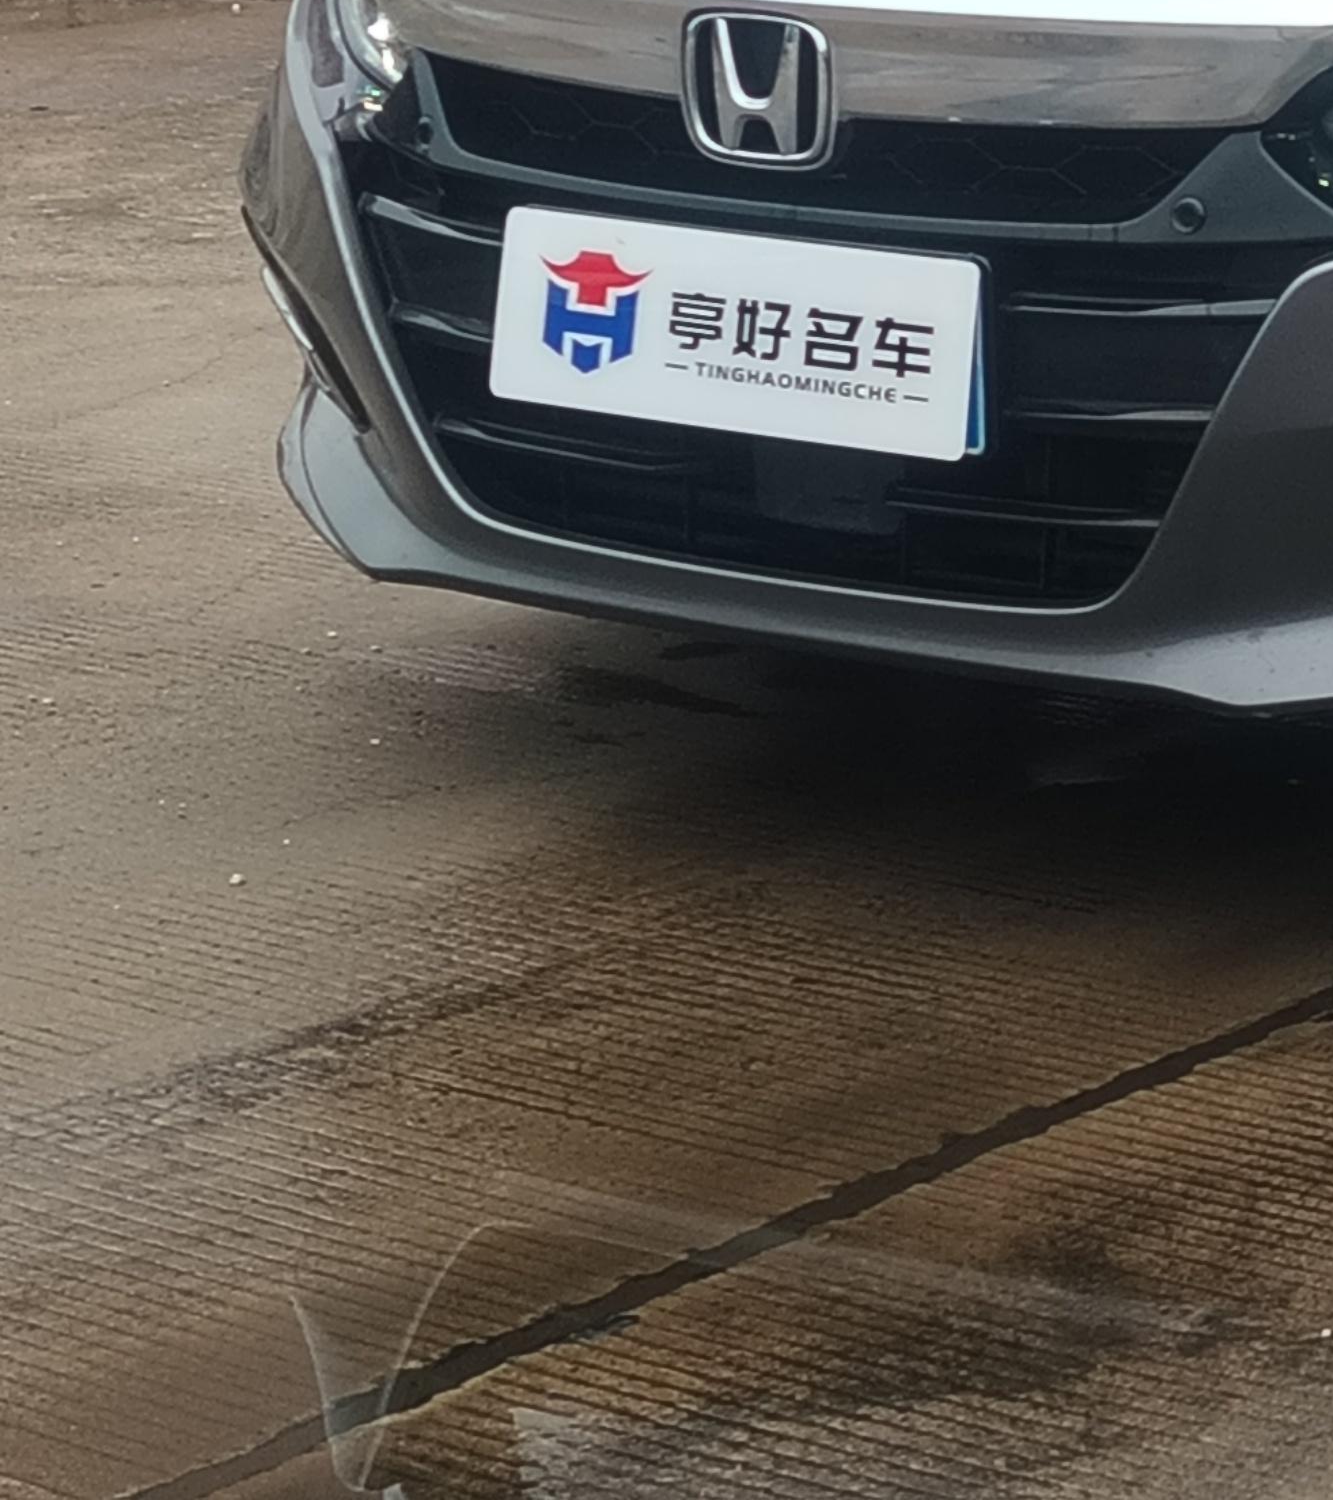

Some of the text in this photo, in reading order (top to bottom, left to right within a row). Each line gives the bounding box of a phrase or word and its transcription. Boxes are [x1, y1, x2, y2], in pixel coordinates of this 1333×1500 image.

[668, 291, 935, 379] 亭好名车
[694, 361, 897, 403] TINGHAOMINGCHE
